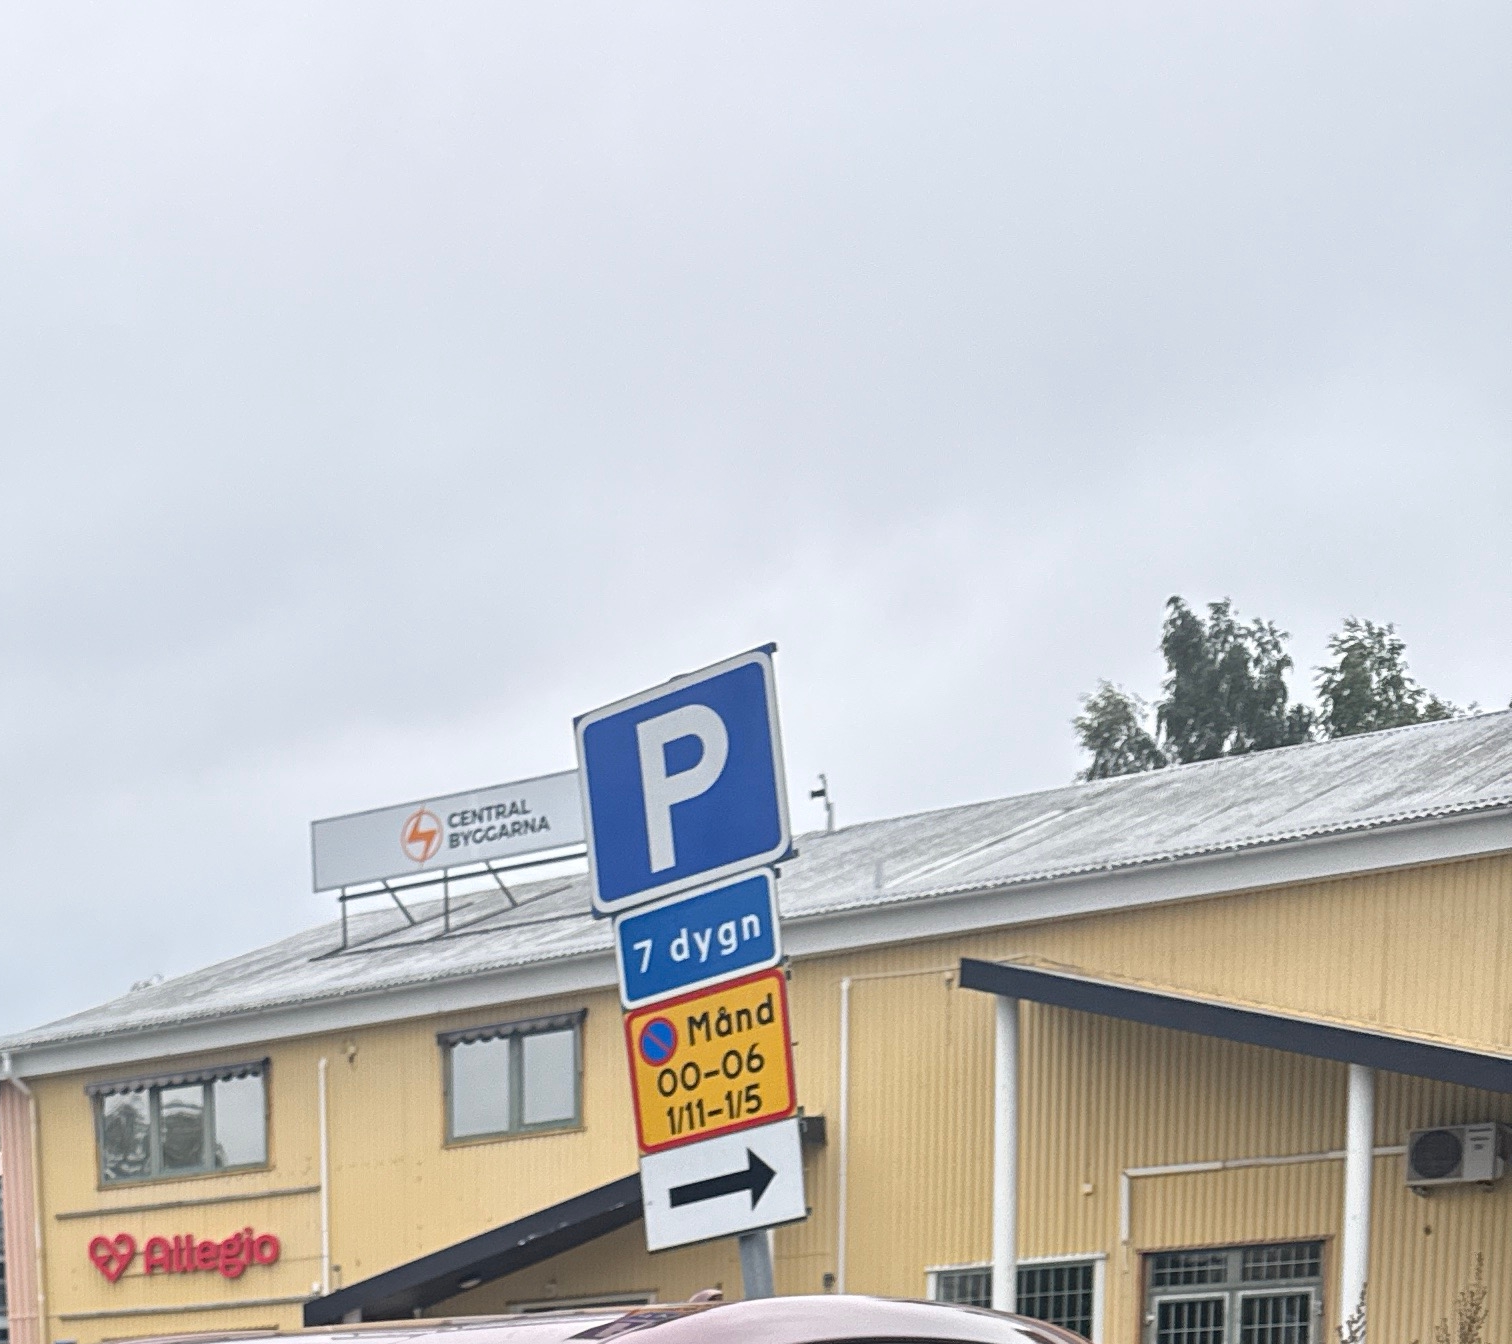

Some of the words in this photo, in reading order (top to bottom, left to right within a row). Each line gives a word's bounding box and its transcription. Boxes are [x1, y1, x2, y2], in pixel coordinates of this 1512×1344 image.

[447, 799, 532, 828] CENTRAL
[636, 704, 729, 874] P
[448, 815, 551, 849] BYGGARNA
[633, 939, 653, 974] 7
[669, 913, 762, 964] dygn
[687, 993, 775, 1047] Månd
[657, 1043, 766, 1098] 00-06
[667, 1083, 763, 1135] 1/11-1/5
[144, 1226, 281, 1279] Allegio
